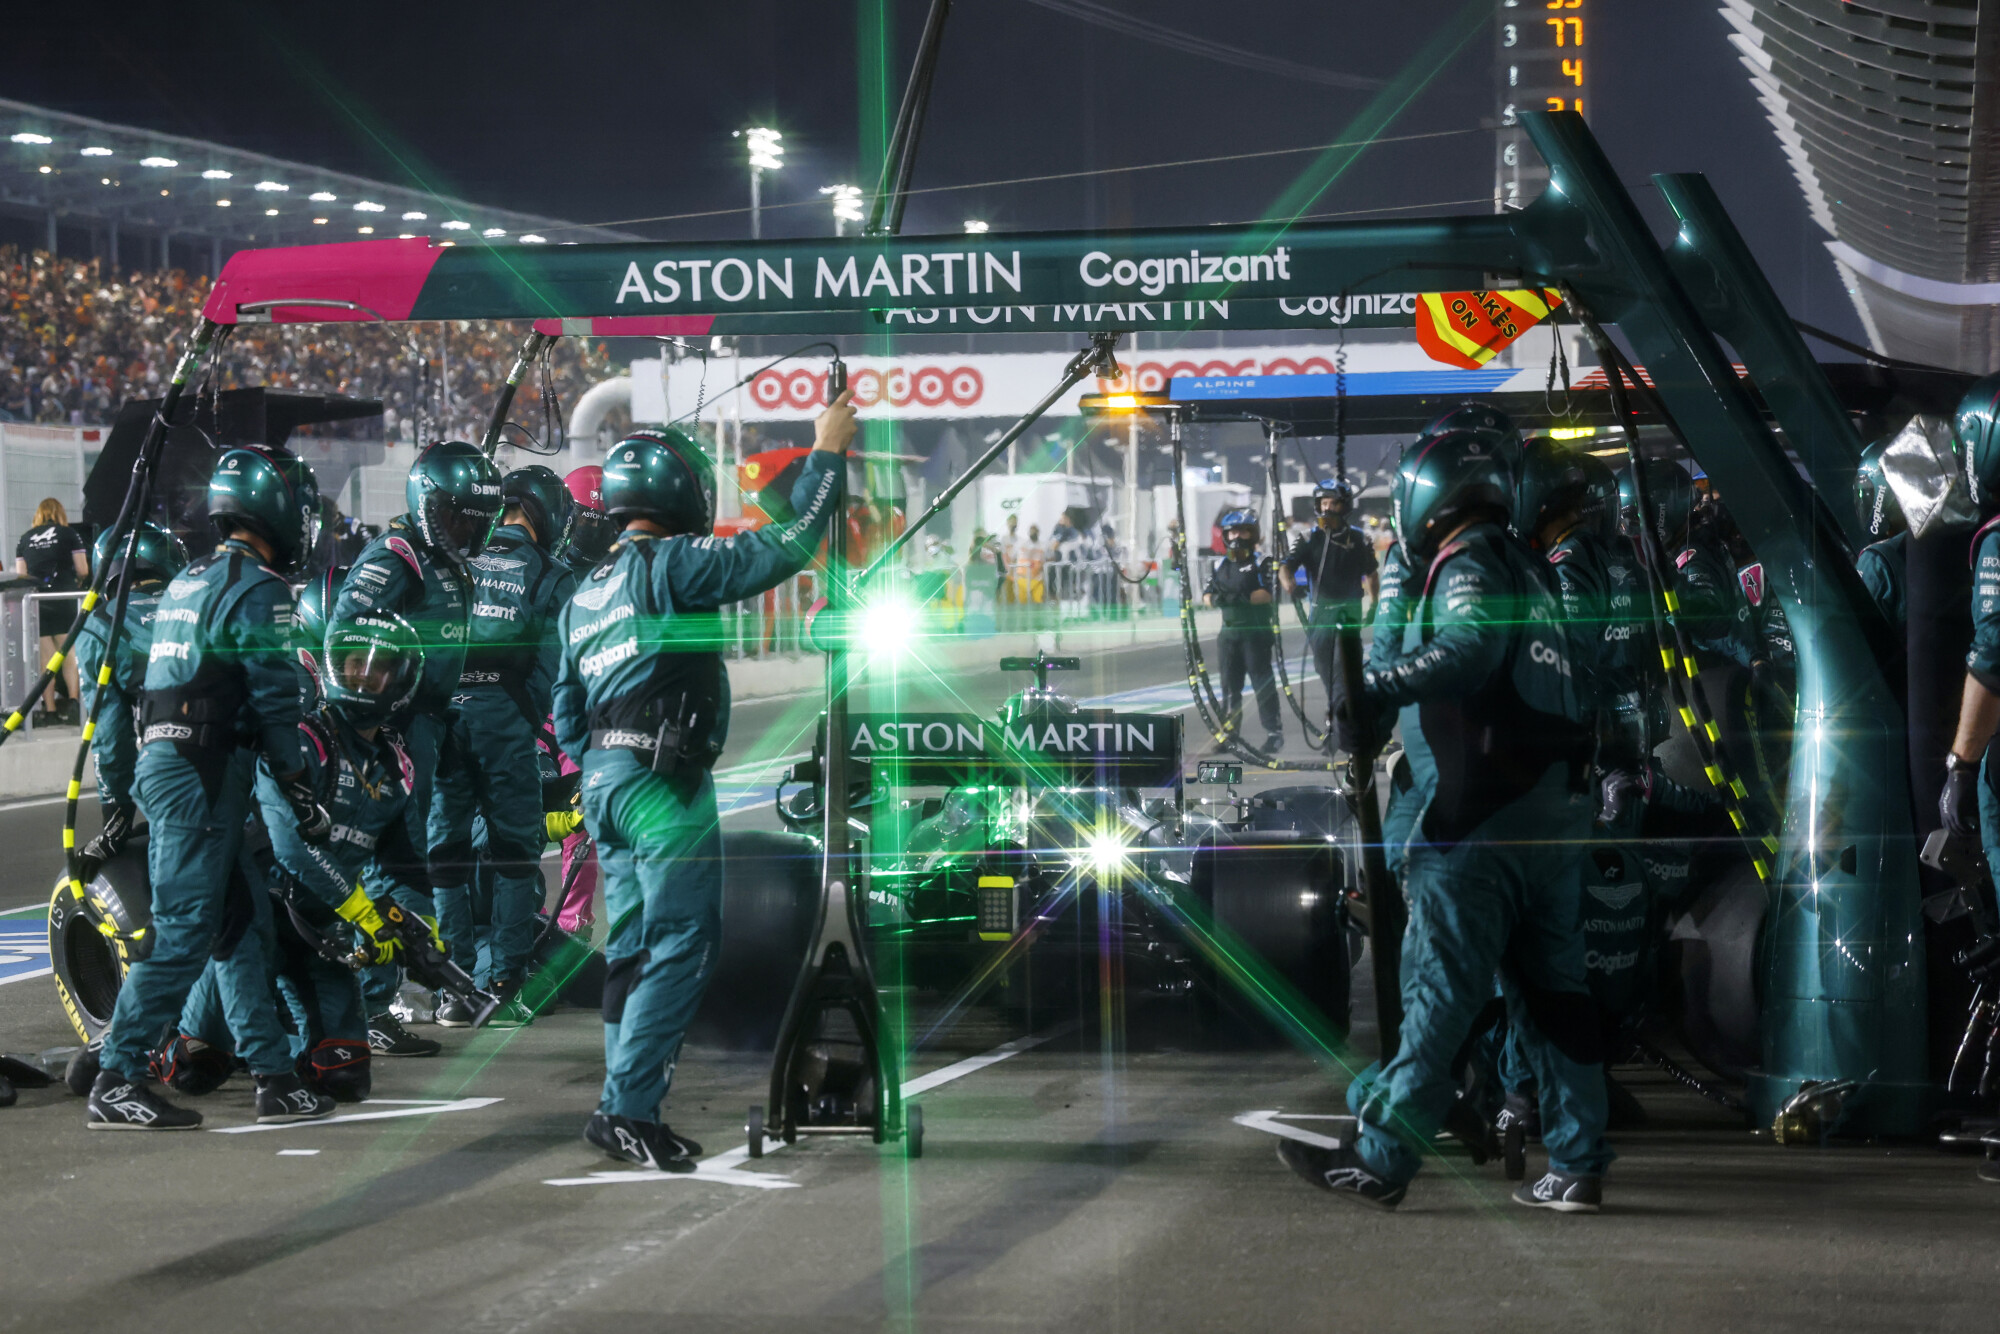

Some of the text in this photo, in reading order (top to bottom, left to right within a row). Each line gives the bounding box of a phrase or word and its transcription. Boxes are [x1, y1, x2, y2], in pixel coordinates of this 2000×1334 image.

[1504, 17, 1583, 47] 3 77
[1562, 59, 1583, 86] 4
[616, 251, 1022, 304] ASTON MARTIN
[1080, 247, 1291, 296] Cognizant
[1279, 292, 1416, 324] Cogniza
[1450, 298, 1481, 329] ON
[1471, 291, 1518, 339] AKES
[750, 366, 984, 411] ooedoo
[1193, 380, 1256, 388] ALPINE
[1964, 440, 1980, 504] Cognizant
[417, 494, 435, 548] Cognizant
[461, 507, 484, 517] ASTON
[582, 511, 602, 521] ASTON
[781, 468, 836, 545] ASTON MARTIN
[1870, 484, 1887, 535] Cognizant
[354, 578, 382, 594] HACKETT
[480, 578, 526, 595] MARTIN
[472, 600, 518, 622] nizant
[1982, 600, 1993, 608] GP
[367, 618, 398, 633] BWT
[569, 603, 635, 645] ASTON MARTIN
[343, 635, 400, 652] ASTON MARTIN
[579, 636, 639, 676] Cognizant
[850, 722, 1155, 753] ASTON MARTIN
[320, 860, 352, 897] MARTIN
